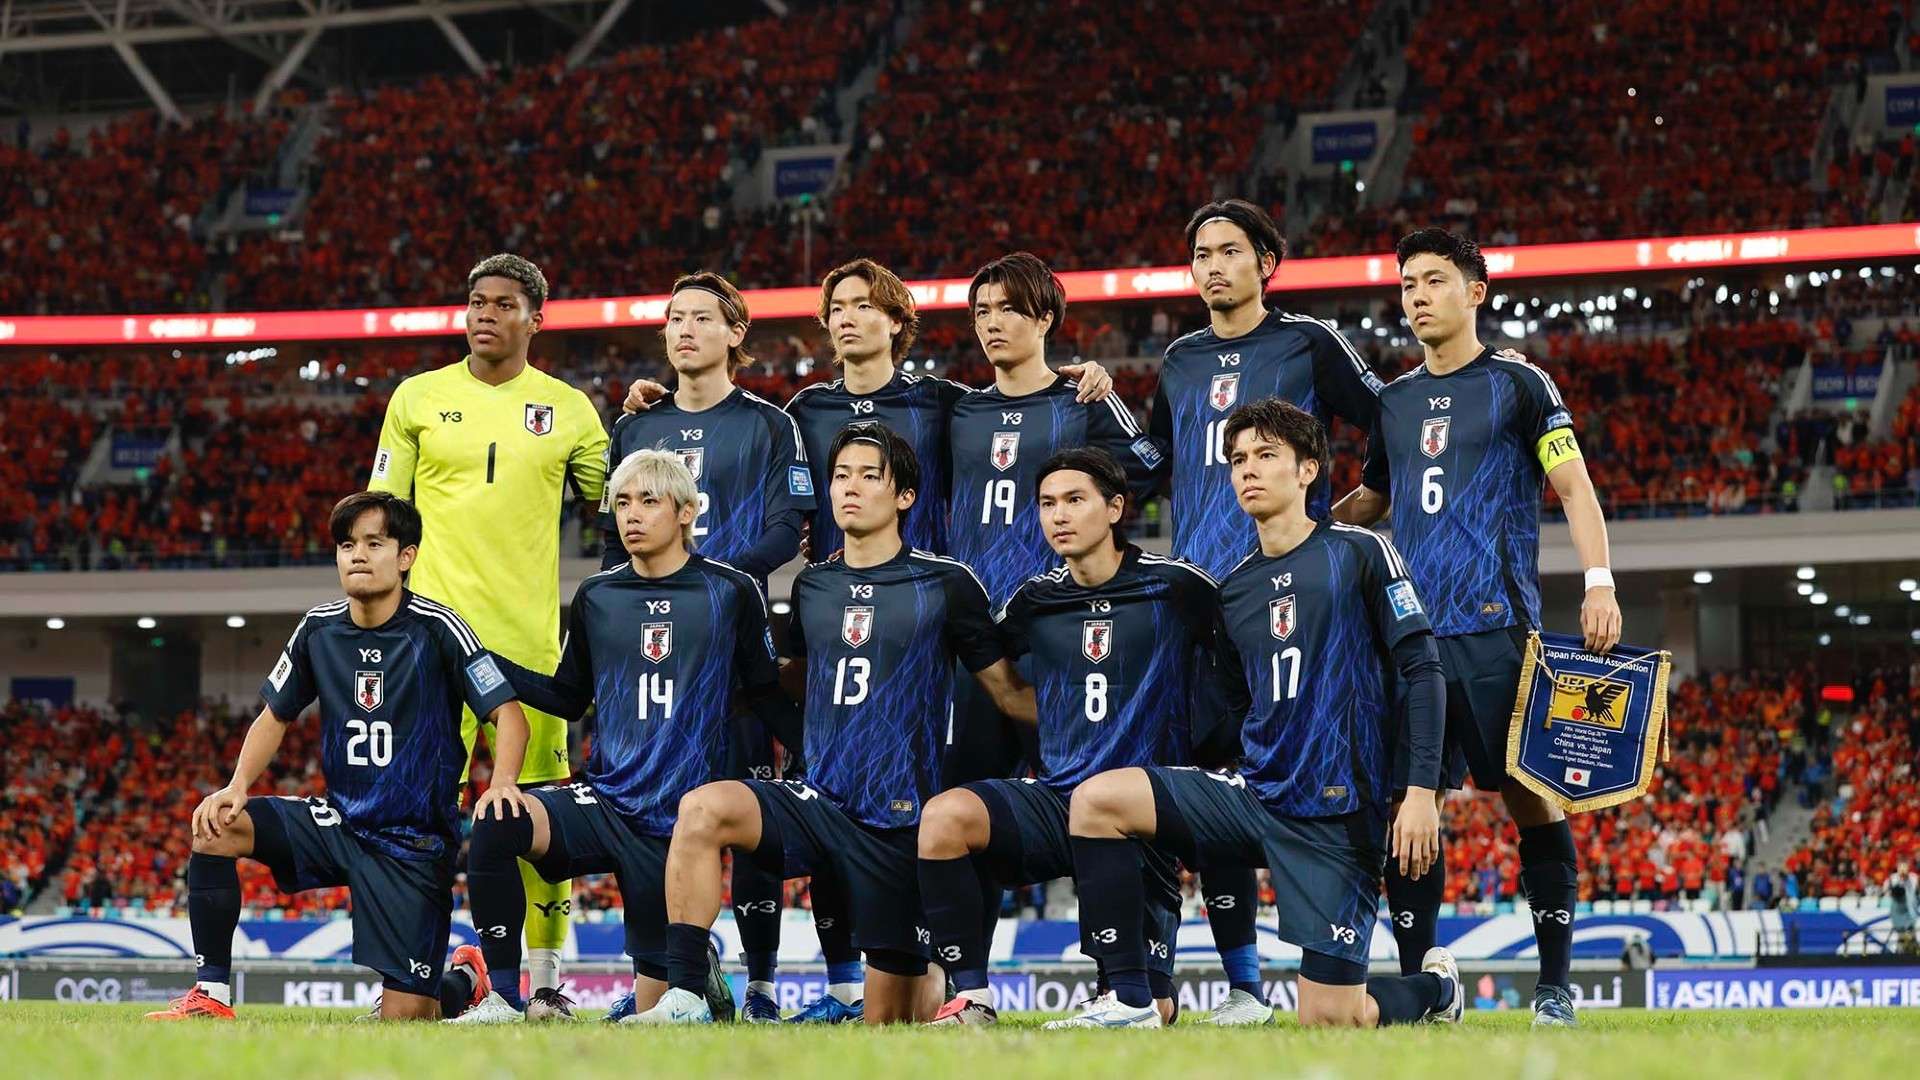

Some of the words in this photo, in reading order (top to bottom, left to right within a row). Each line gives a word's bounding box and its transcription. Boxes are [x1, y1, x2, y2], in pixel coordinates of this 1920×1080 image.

[1217, 353, 1240, 367] Y-3
[850, 400, 874, 415] Y-3
[1428, 396, 1451, 410] Y-3
[439, 411, 463, 423] Y-3
[1001, 412, 1023, 425] Y-3
[680, 428, 703, 441] Y-3
[486, 442, 497, 484] 1
[1421, 466, 1445, 514] 6
[981, 479, 1016, 525] 19
[1271, 572, 1292, 591] Y-3
[849, 584, 874, 599] Y-3
[645, 600, 671, 615] Y-3
[1086, 599, 1111, 613] Y-3
[358, 648, 382, 663] Y-3
[1545, 649, 1569, 660] Japan
[1570, 652, 1604, 665] Football
[1604, 657, 1649, 673] Assoation
[833, 656, 871, 705] 13
[1271, 646, 1302, 702] 17
[638, 671, 674, 721] 14
[1084, 672, 1108, 722] 8
[346, 719, 392, 767] 20
[1553, 737, 1574, 748] China
[1590, 744, 1612, 755] Japan
[749, 765, 772, 780] Y-3
[533, 900, 571, 917] Y-3
[737, 900, 777, 916] Y-3
[1532, 909, 1570, 925] Y-3
[915, 926, 931, 945] Y-3
[1330, 923, 1356, 945] Y-3
[1148, 939, 1168, 959] Y-3
[409, 957, 431, 979] Y-3
[1672, 979, 1774, 1009] ASIAN
